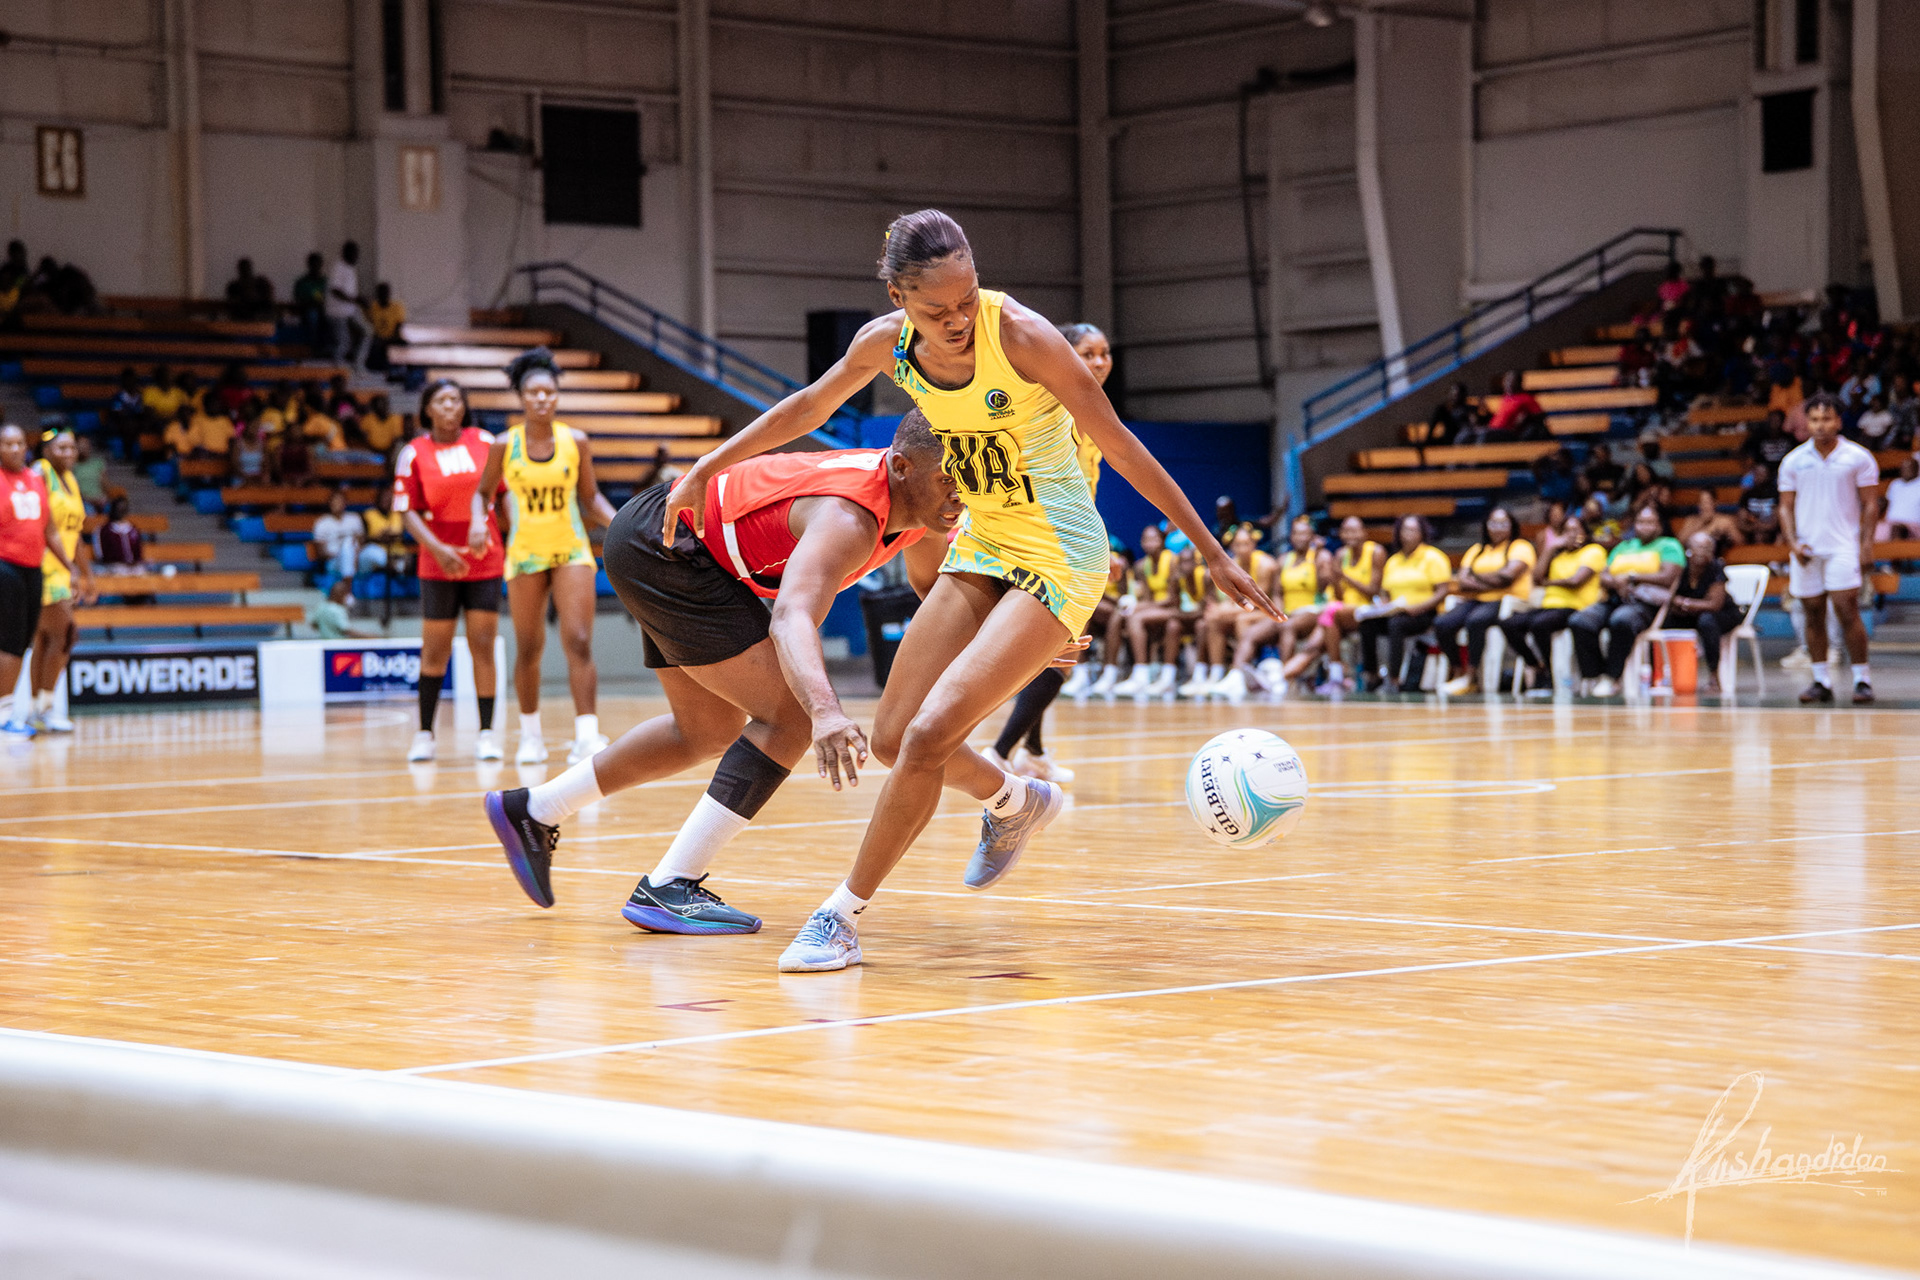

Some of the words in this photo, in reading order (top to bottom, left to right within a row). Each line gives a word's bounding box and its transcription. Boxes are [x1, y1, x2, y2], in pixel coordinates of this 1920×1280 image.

[435, 445, 477, 477] WA
[72, 655, 257, 696] POWERADE
[361, 651, 421, 683] Budg
[1201, 756, 1240, 836] GILBERT
